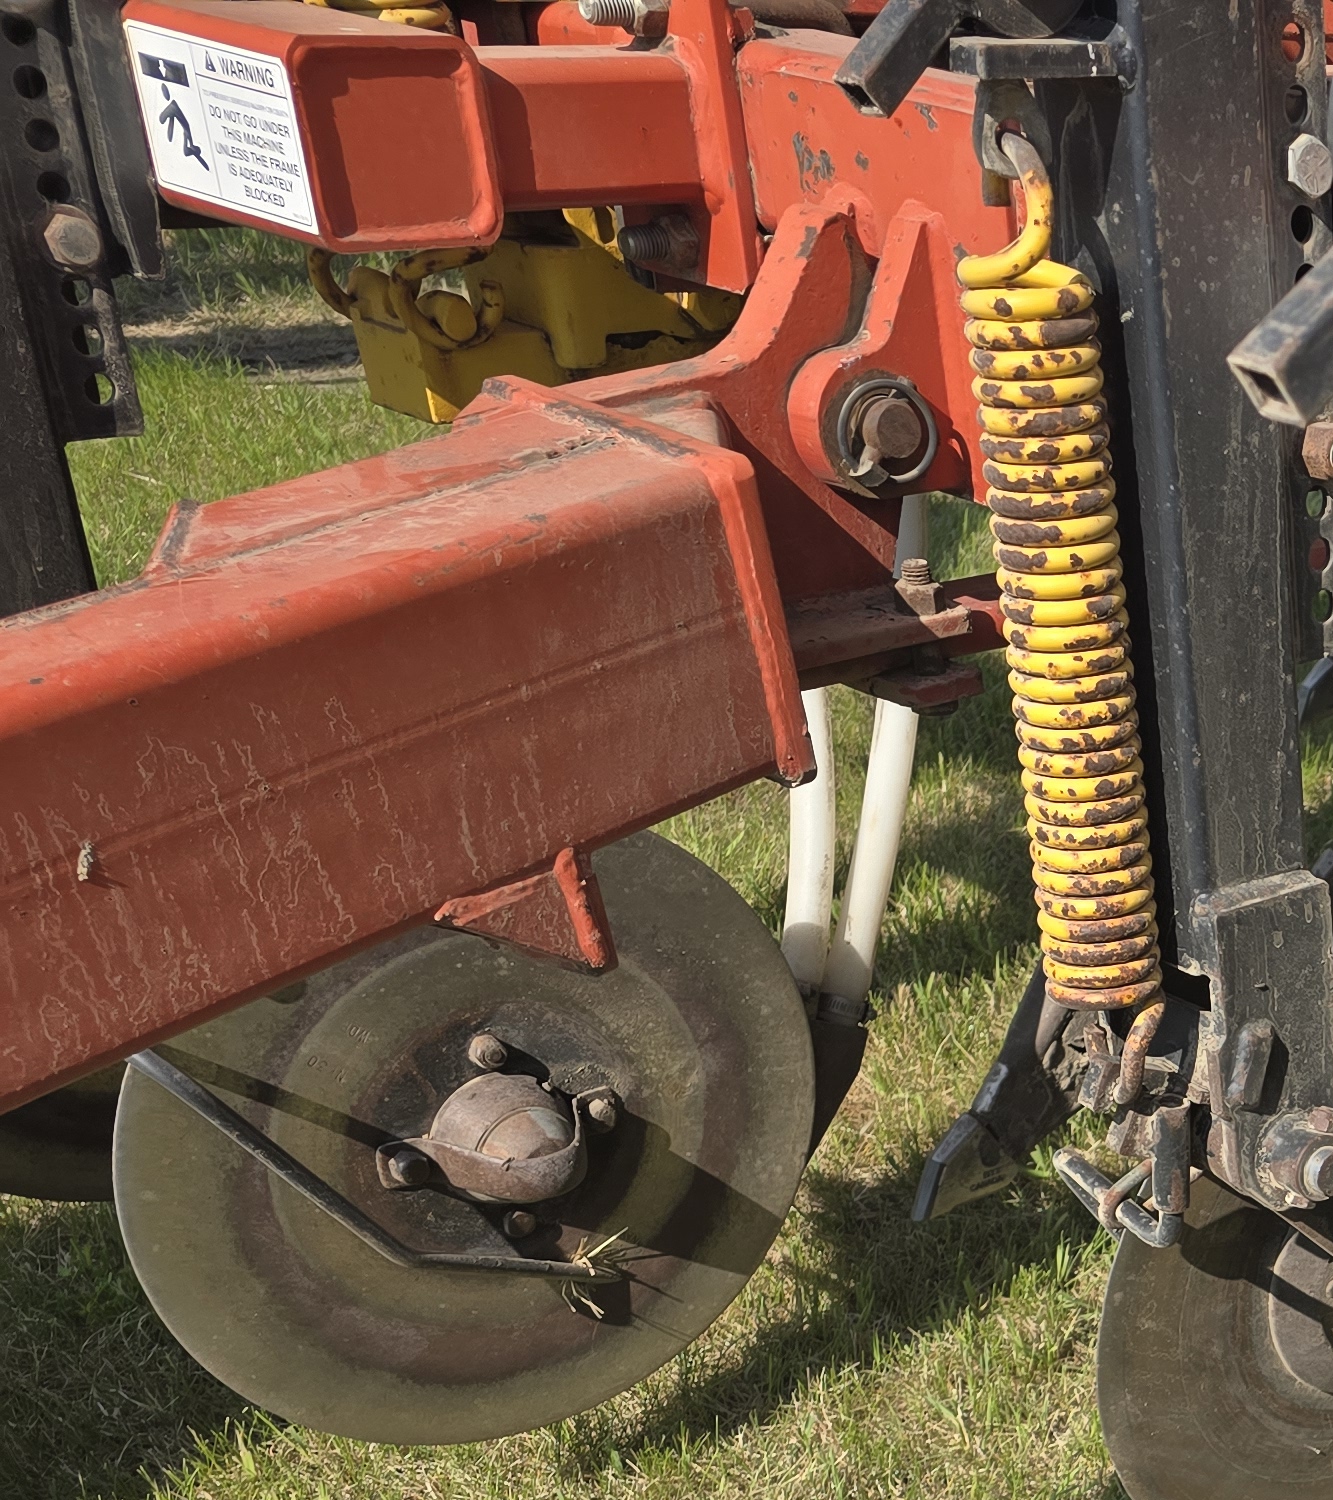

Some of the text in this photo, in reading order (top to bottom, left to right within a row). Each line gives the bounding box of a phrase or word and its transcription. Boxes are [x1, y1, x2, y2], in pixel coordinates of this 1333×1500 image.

[218, 56, 275, 88] WARNING
[209, 105, 290, 139] DO NOT GO UNDER
[222, 126, 285, 155] THIS MACHINE
[216, 142, 300, 177] UNLESS THE FRAME
[229, 163, 293, 192] IS ADEQUATELY
[245, 185, 285, 207] BLOCKED
